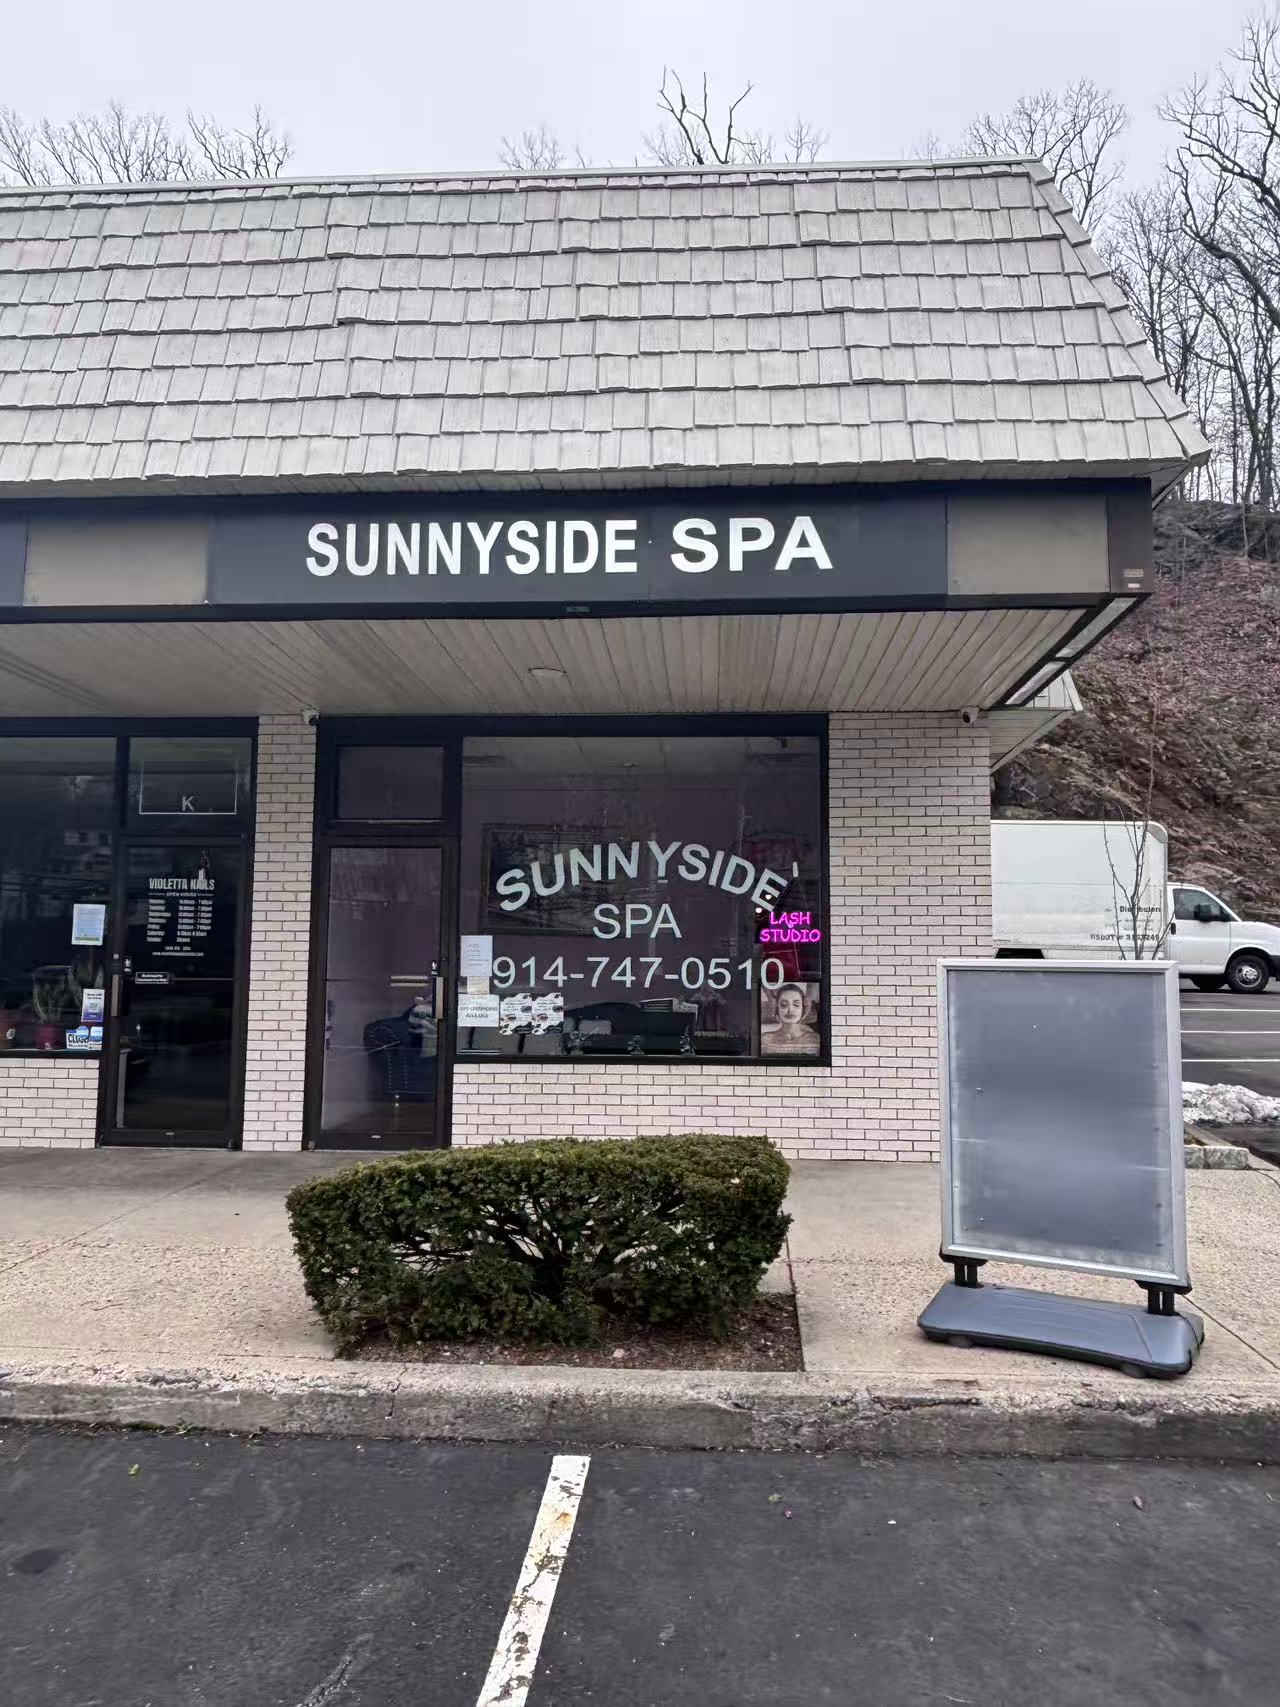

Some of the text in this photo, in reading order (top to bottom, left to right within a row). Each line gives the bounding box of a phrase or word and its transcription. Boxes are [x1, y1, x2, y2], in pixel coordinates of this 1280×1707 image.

[306, 515, 834, 577] SUNNYSIDE SPA
[181, 796, 195, 812] K
[149, 878, 215, 891] VIOLETTA NAILS
[495, 840, 788, 912] SUNNYSIDE
[592, 903, 682, 940] SPA
[769, 912, 812, 926] LASH
[760, 927, 821, 944] STUDIO
[493, 956, 785, 991] 914-747-0510
